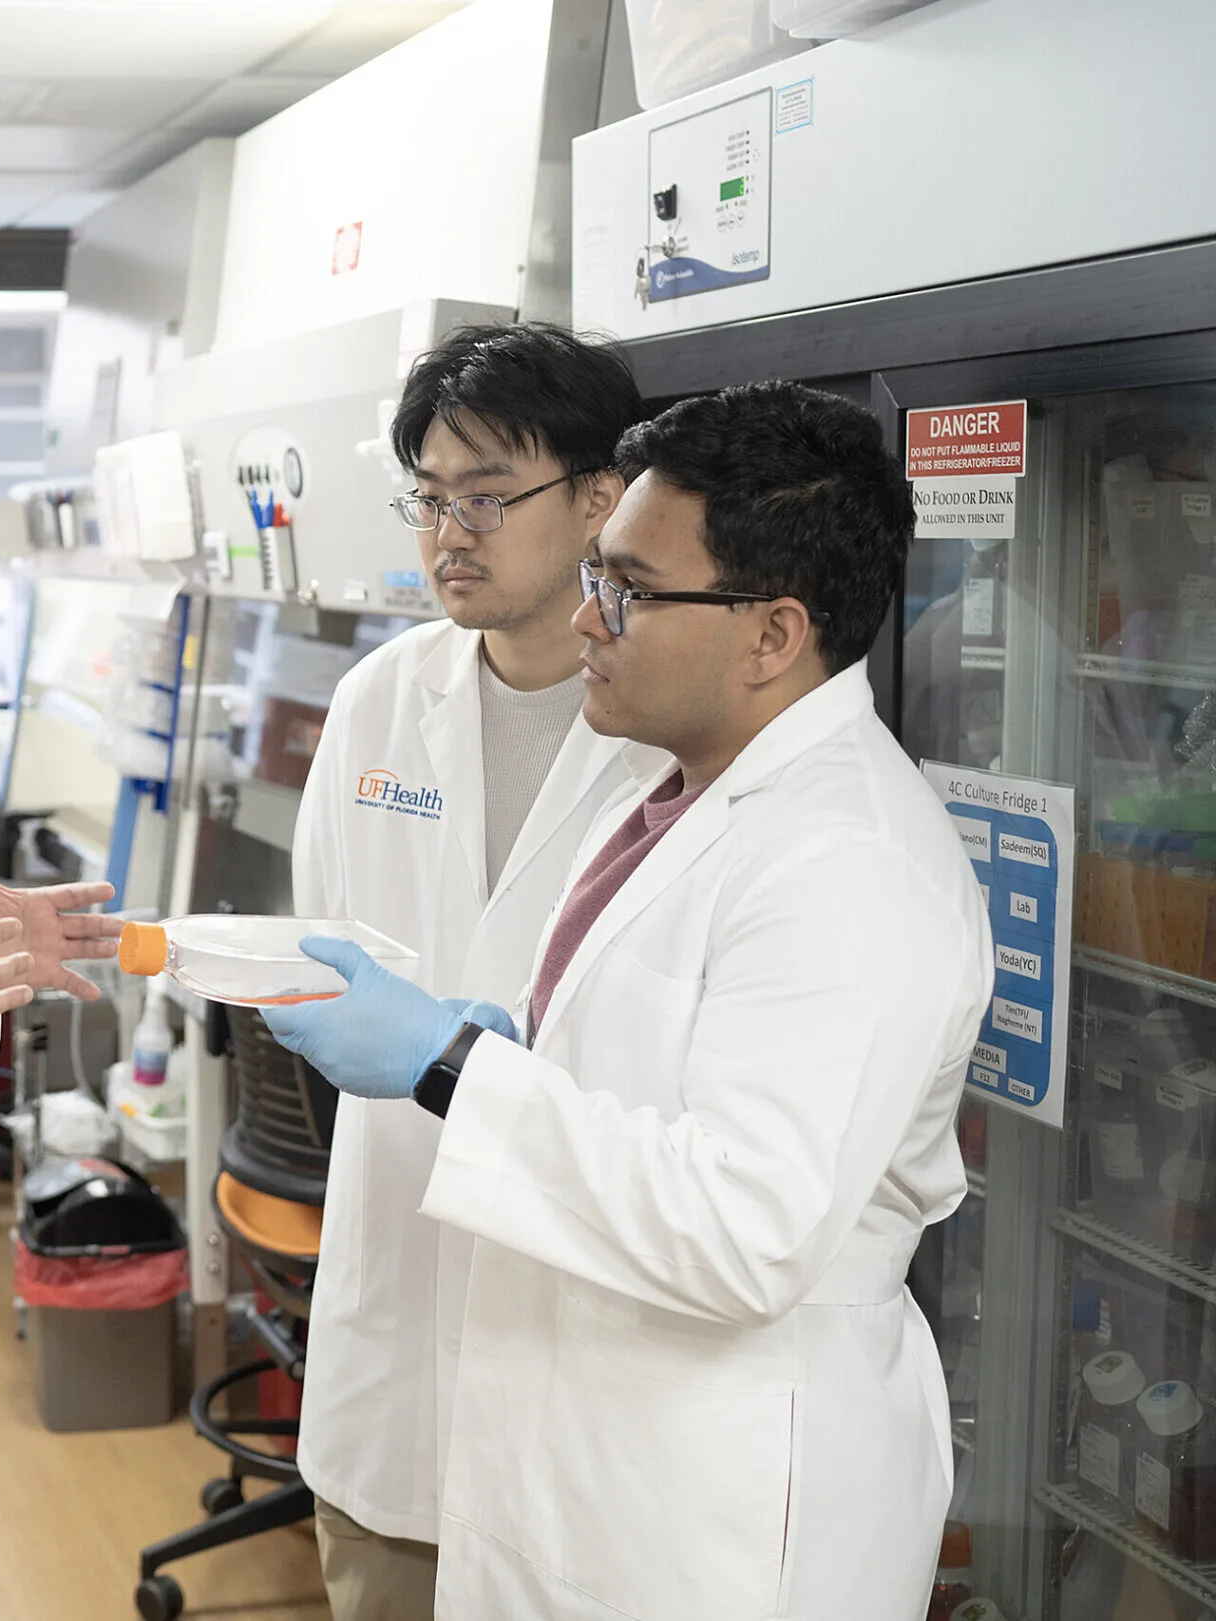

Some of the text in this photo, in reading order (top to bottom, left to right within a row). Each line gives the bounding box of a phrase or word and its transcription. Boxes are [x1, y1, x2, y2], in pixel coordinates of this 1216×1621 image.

[930, 411, 1000, 438] DANGER
[911, 441, 1021, 457] DO NOT PUT FLAMMABLE LIQUID
[909, 456, 1021, 471] IN THIS REFRIGERATOR/FREEZER
[921, 513, 1005, 524] ALLOWED IN THIS UNIT
[948, 781, 1047, 813] 4C Culture Fridge 1
[355, 798, 385, 809] UNIVERSITY
[395, 806, 418, 816] FLORIDA
[419, 810, 440, 820] HEALTH
[1000, 839, 1047, 861] Sadeem(SQ)
[1016, 900, 1031, 914] Lab
[999, 951, 1037, 974] Yoda(YC)
[973, 1046, 1000, 1065] MEDIA
[1011, 1084, 1031, 1098] OTHER
